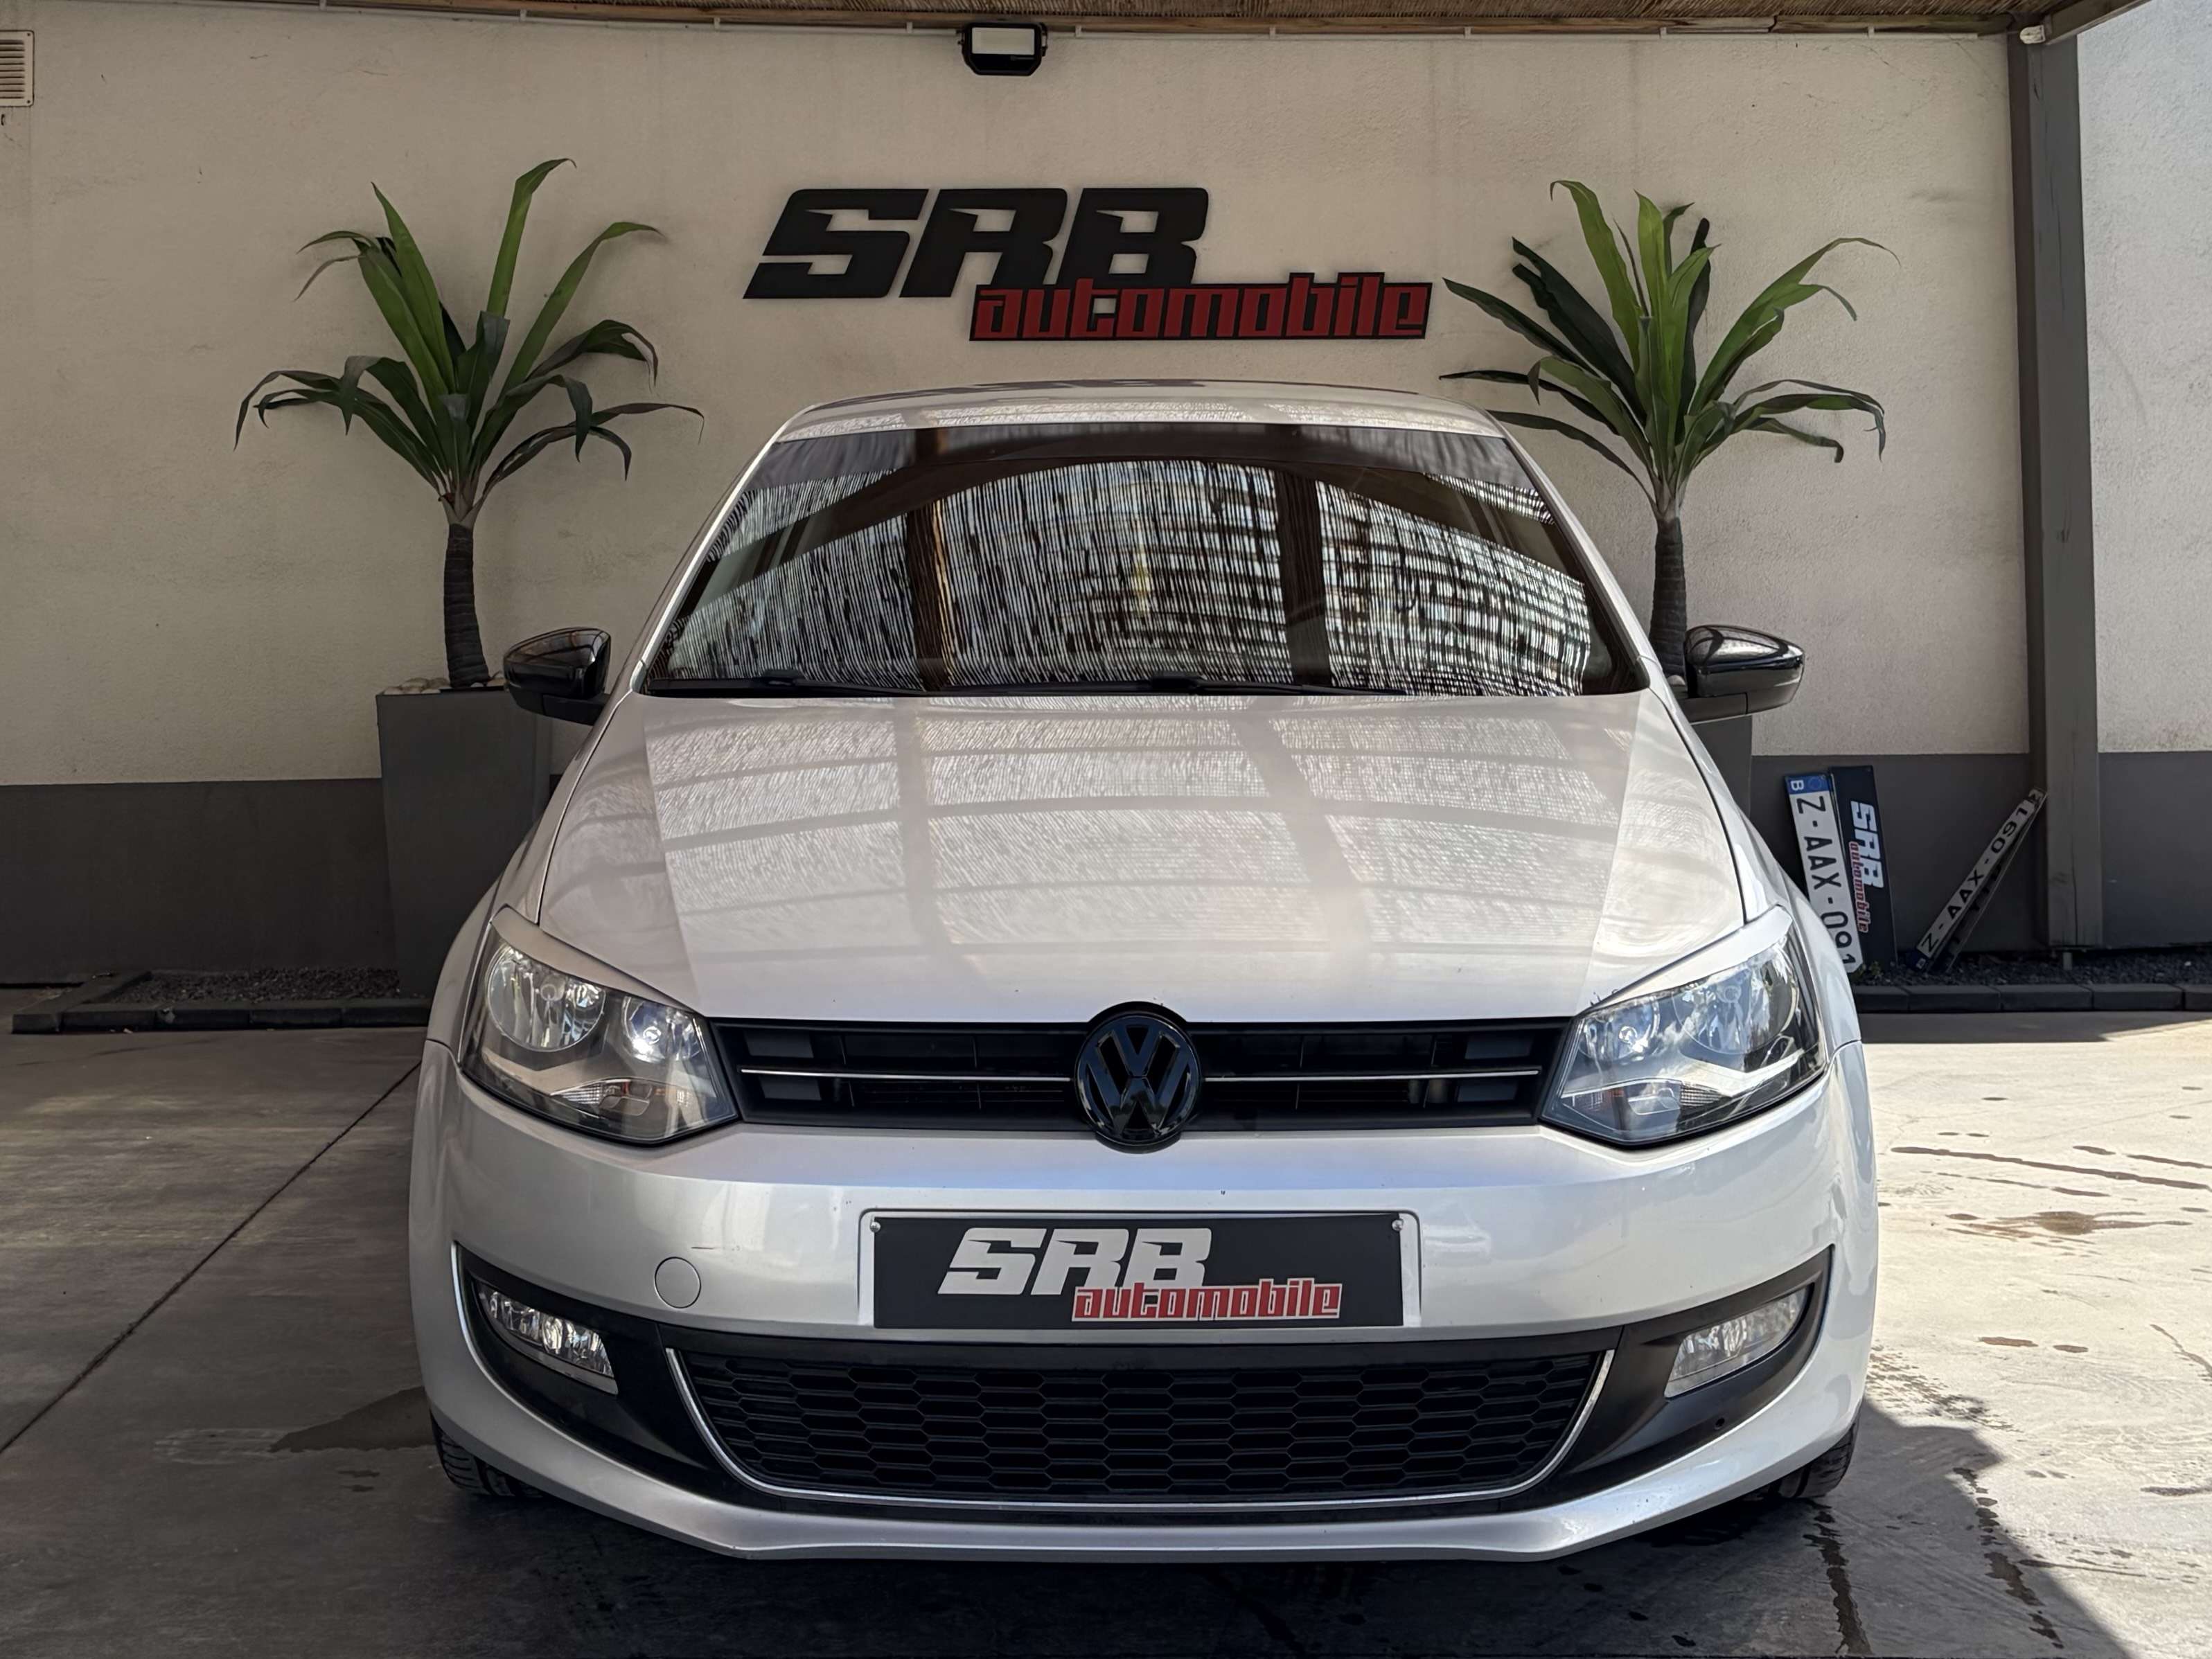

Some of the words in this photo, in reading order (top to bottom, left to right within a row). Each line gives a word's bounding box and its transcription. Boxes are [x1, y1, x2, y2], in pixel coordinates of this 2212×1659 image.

[743, 187, 1209, 299] SRB
[971, 273, 1432, 340] automobile
[1790, 779, 1804, 791] B
[1850, 801, 1884, 888] SRB
[1921, 807, 2028, 953] Z-AAX-091
[1848, 841, 1870, 933] automobile
[938, 1227, 1212, 1295] SRB
[1072, 1277, 1343, 1322] automobile
